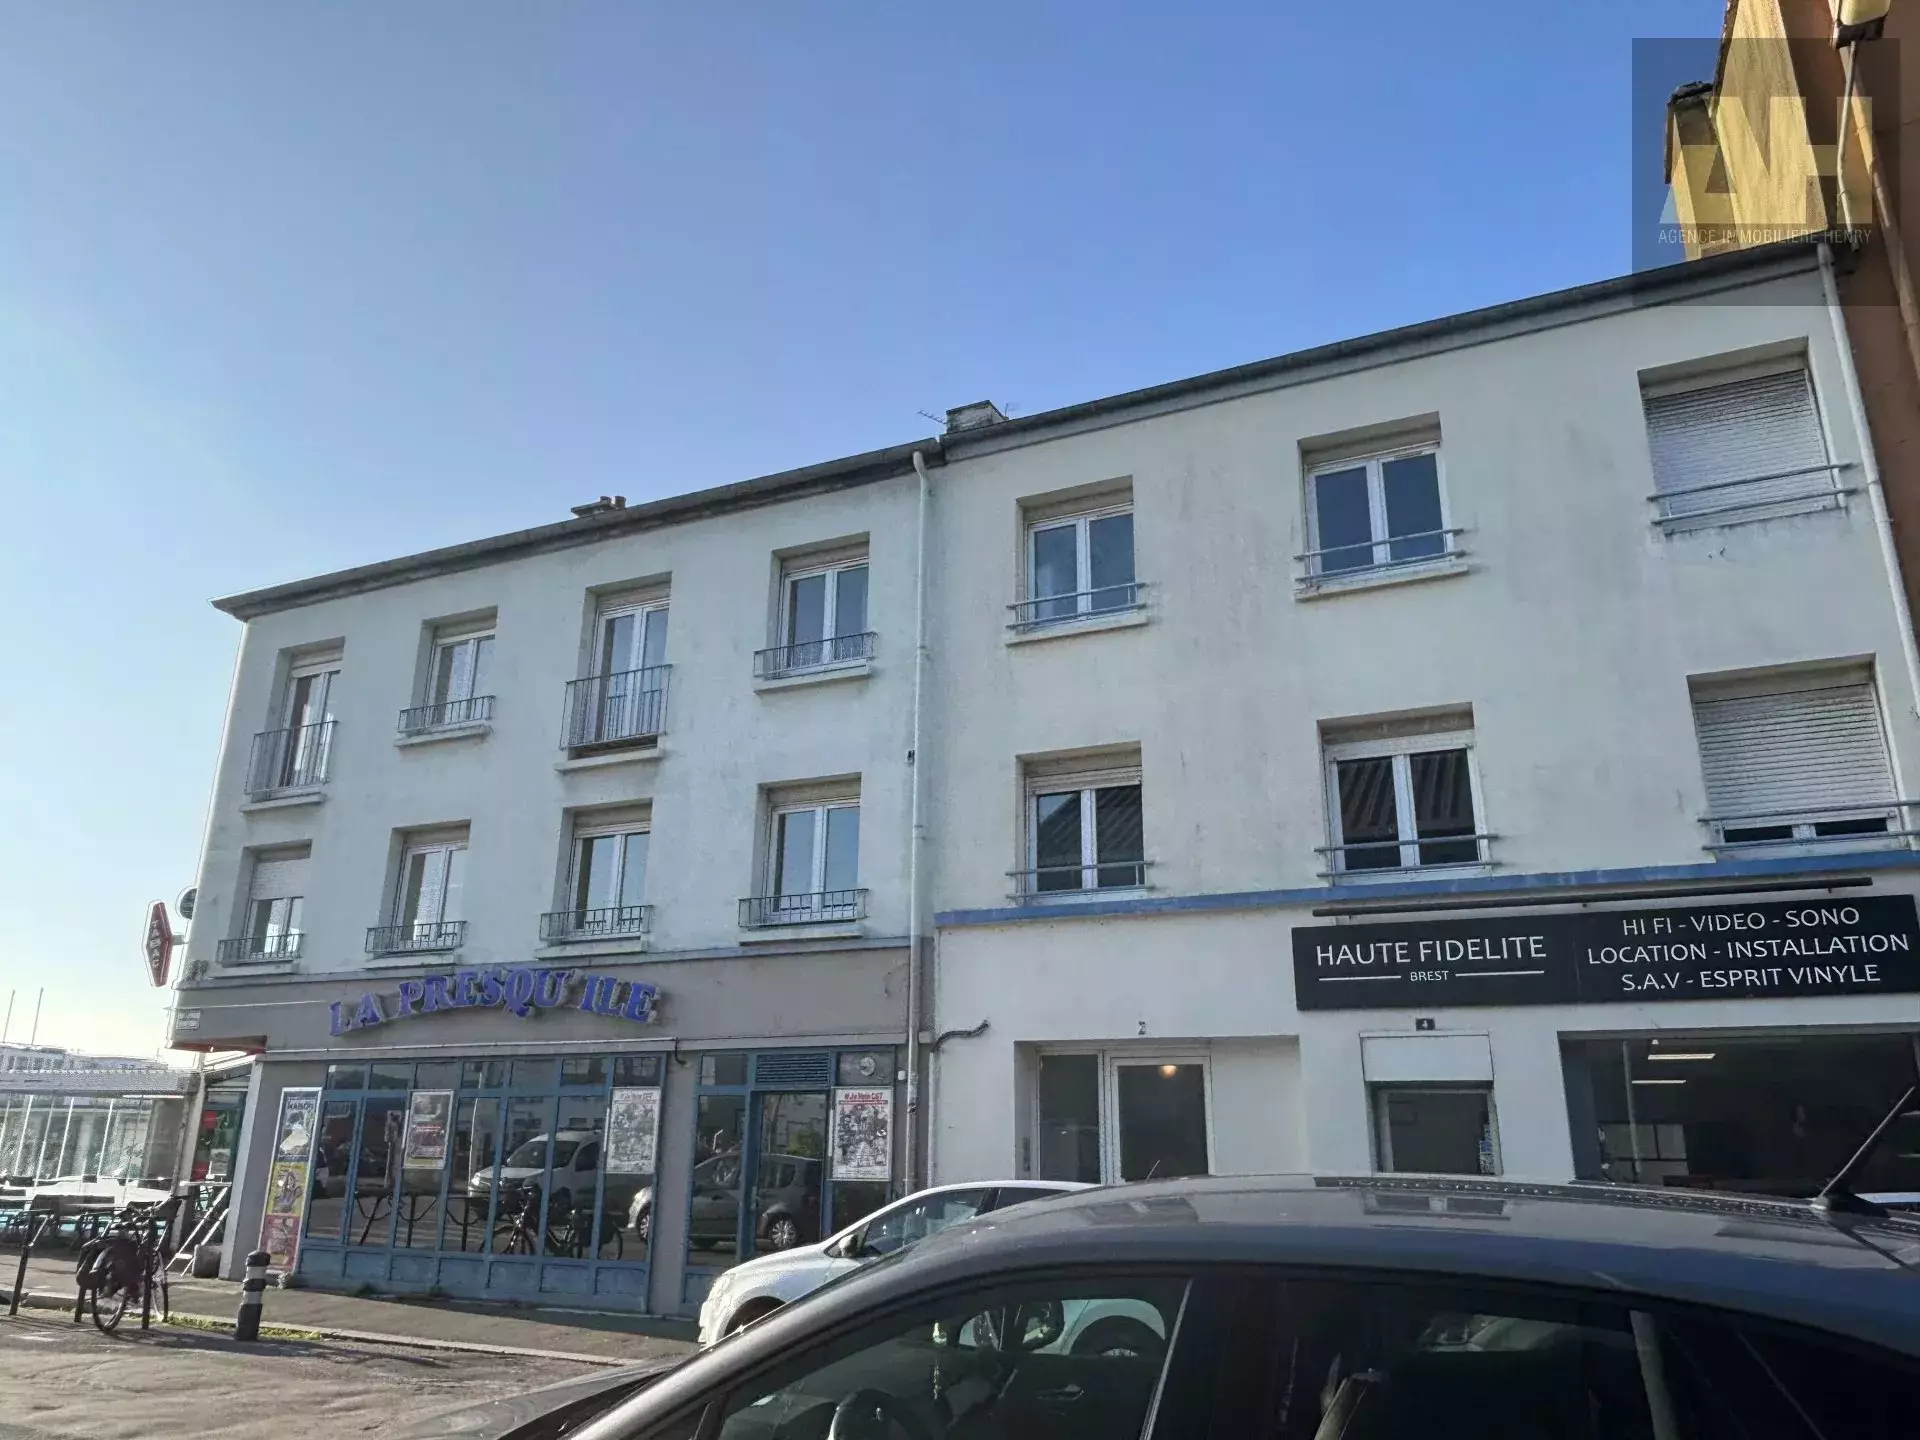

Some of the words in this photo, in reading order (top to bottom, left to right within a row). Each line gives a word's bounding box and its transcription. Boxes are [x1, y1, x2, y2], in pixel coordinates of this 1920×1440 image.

[1623, 918, 1645, 936] HI
[1653, 917, 1672, 934] FI
[1690, 912, 1766, 932] VIDEO
[1785, 907, 1860, 928] SONO
[149, 919, 162, 969] TABAC
[1316, 941, 1411, 966] HAUTE
[1419, 935, 1547, 962] FIDELITE
[1587, 943, 1707, 965] LOCATION
[1727, 933, 1910, 959] INSTALLATION
[1410, 970, 1450, 982] BREST
[1621, 972, 1680, 991] S.A.V
[1700, 968, 1782, 988] ESPRIT
[1787, 964, 1881, 985] VINYLE
[328, 991, 386, 1037] LA
